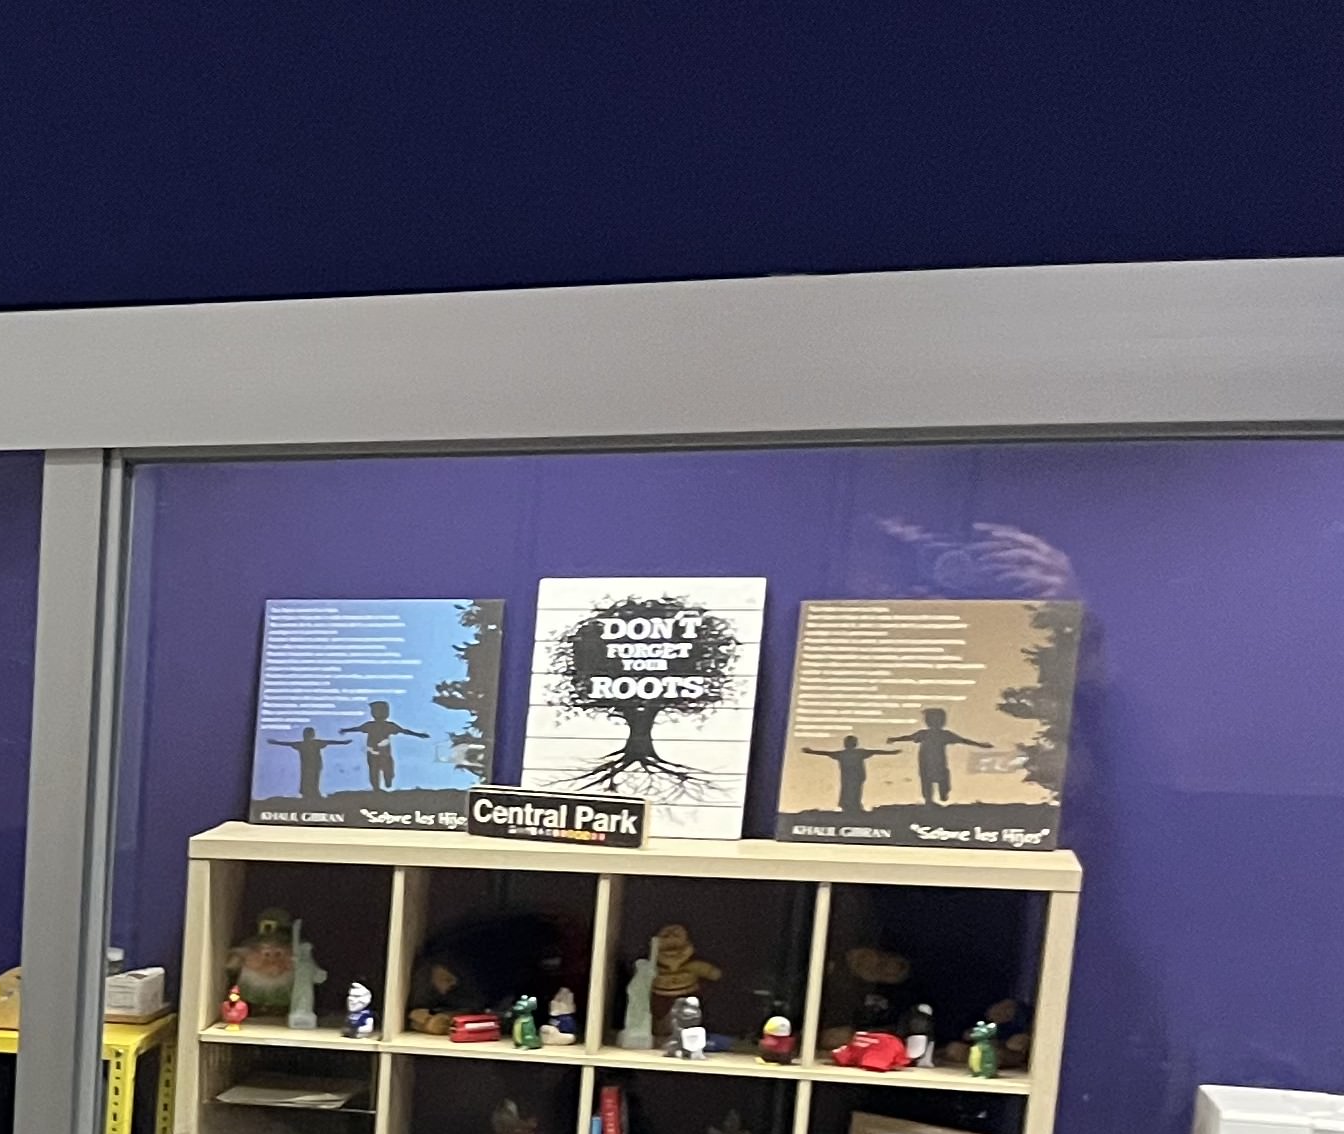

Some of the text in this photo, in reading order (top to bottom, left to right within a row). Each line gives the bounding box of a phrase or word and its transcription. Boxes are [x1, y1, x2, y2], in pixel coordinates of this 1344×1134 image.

[606, 642, 693, 659] FORGET
[588, 676, 705, 700] ROOTS
[473, 799, 567, 829] Central
[575, 805, 639, 834] Park
